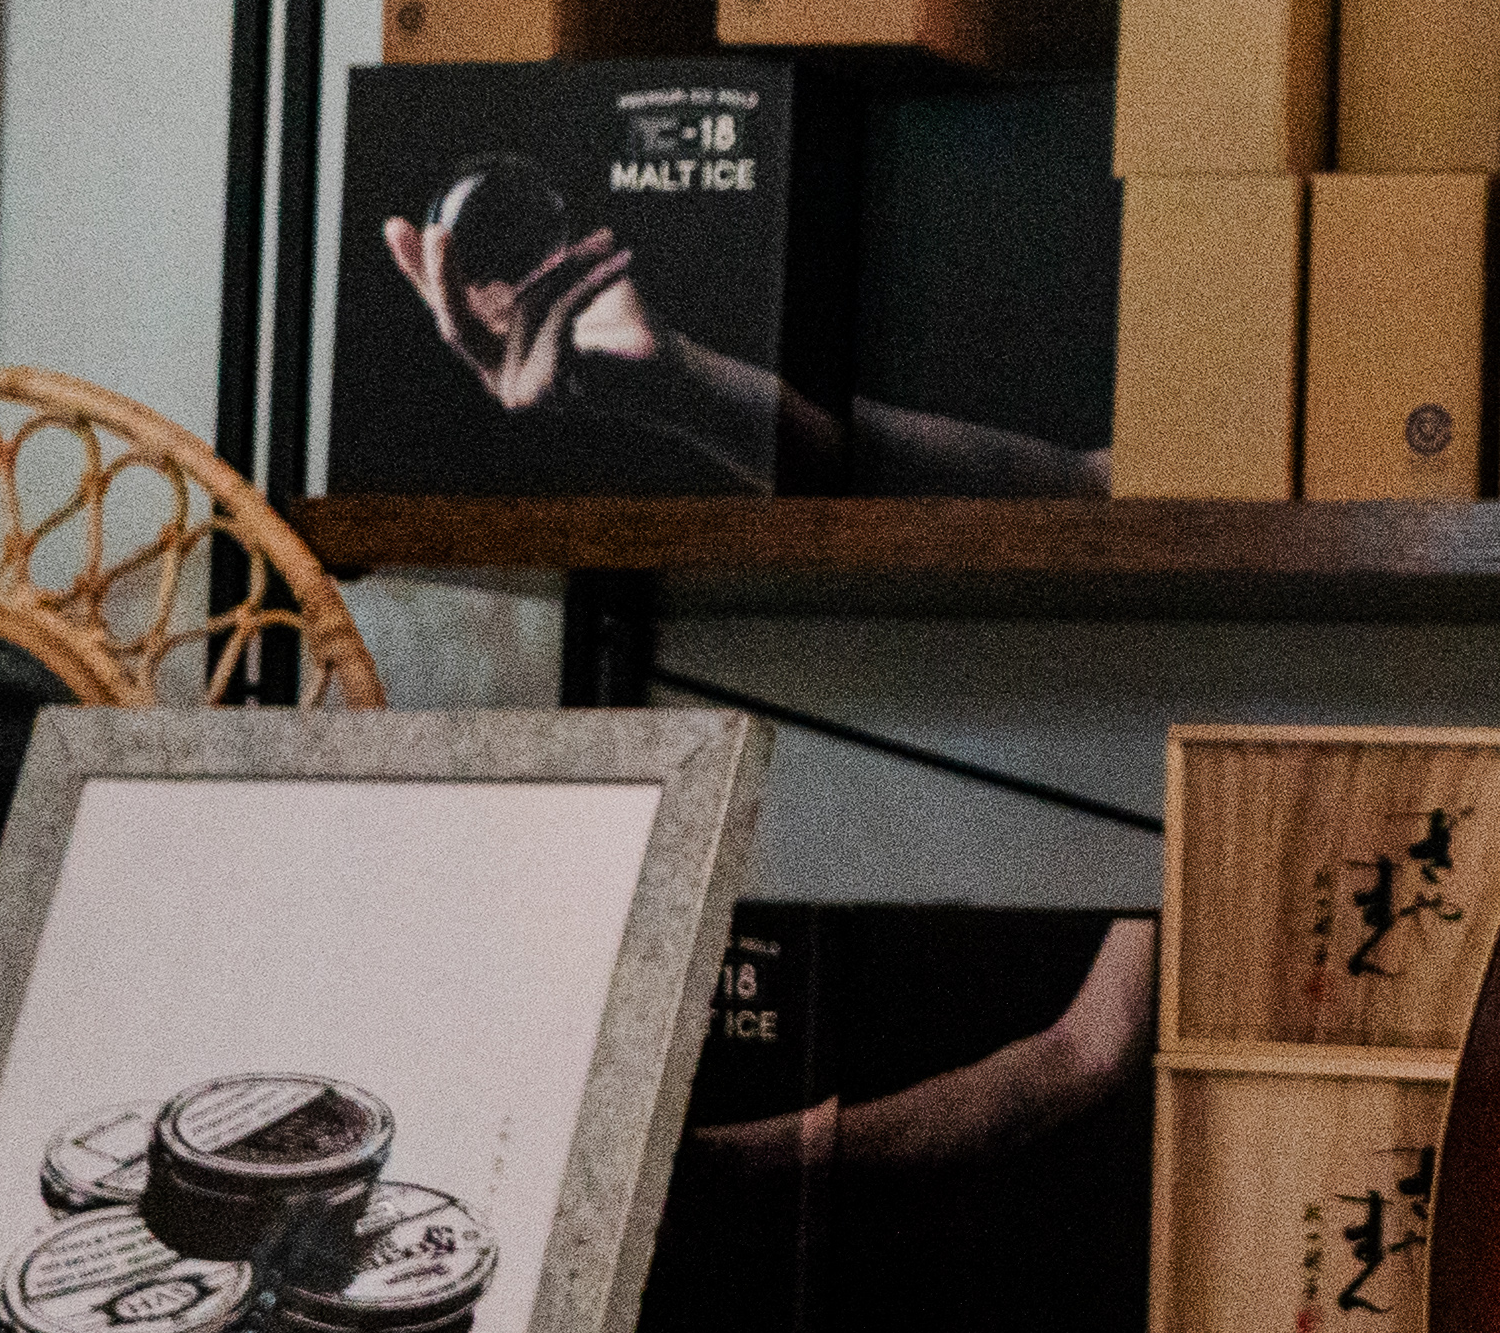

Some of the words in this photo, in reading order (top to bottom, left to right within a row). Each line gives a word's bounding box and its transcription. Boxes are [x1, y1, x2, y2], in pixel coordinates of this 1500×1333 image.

[611, 159, 696, 192] MALT
[702, 158, 756, 192] ICE
[724, 1008, 779, 1043] ICE
